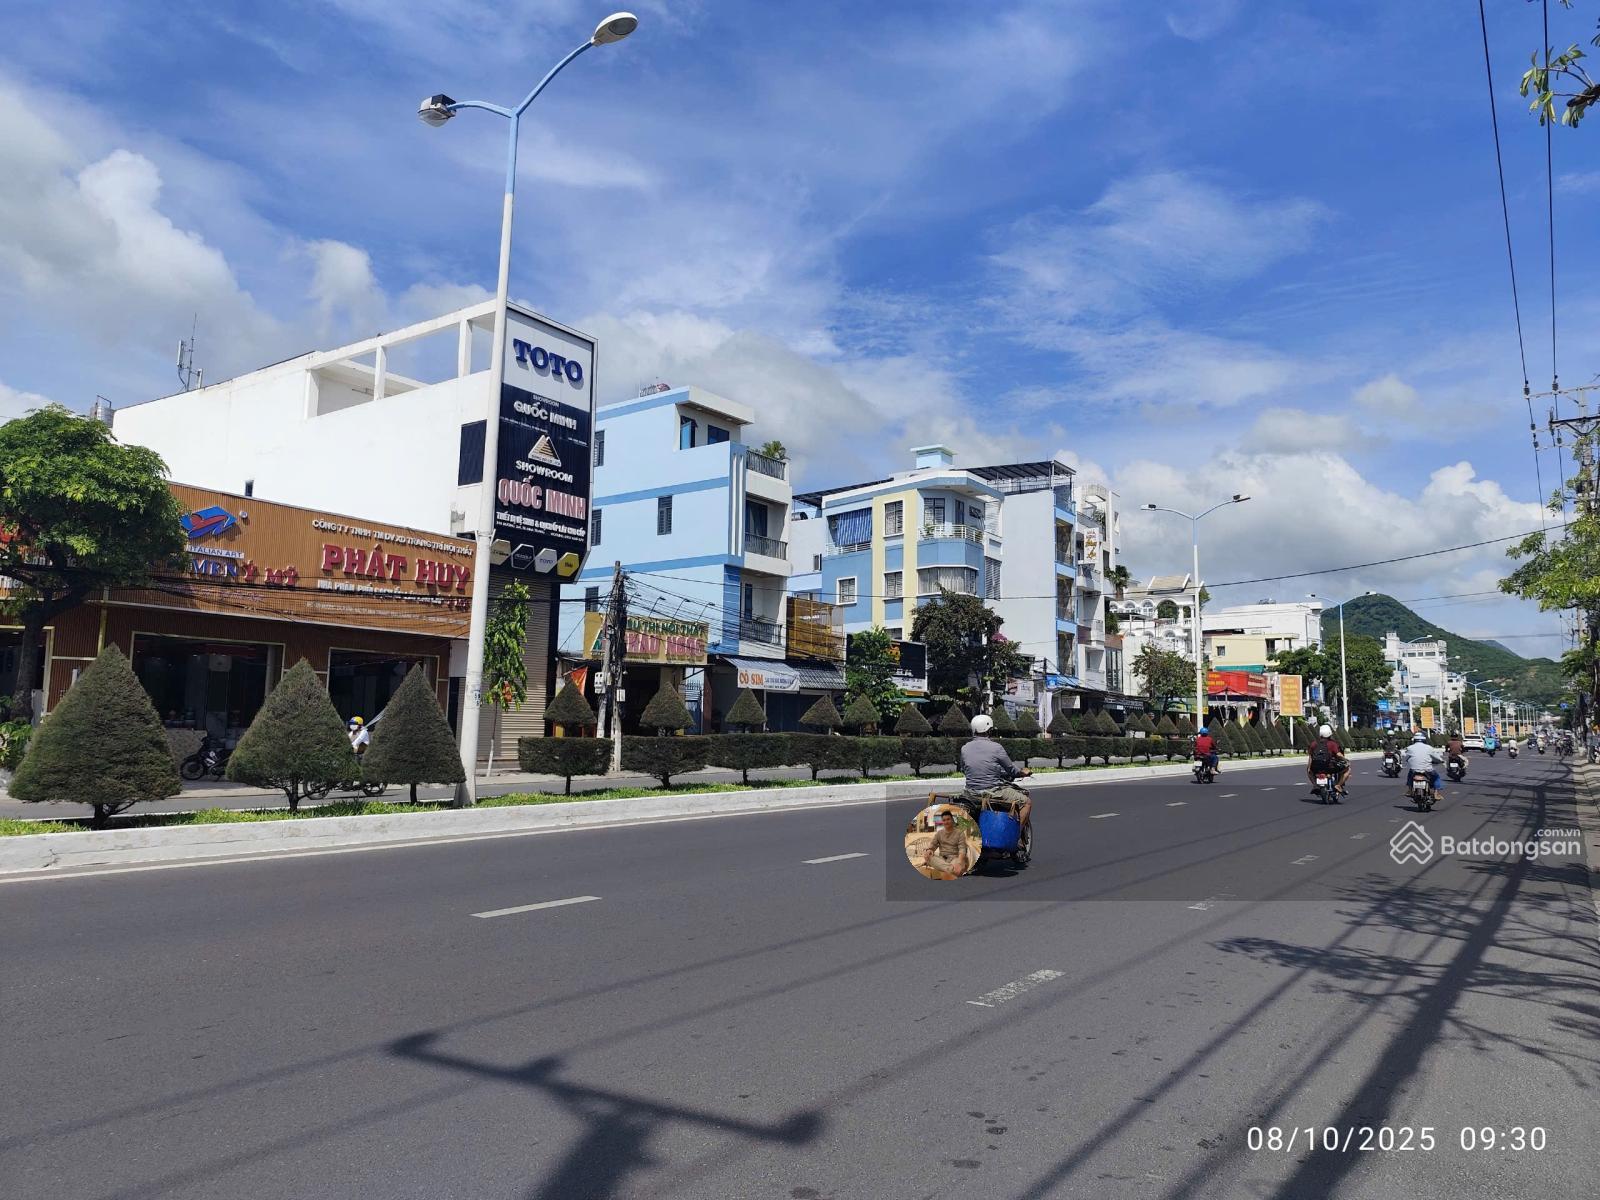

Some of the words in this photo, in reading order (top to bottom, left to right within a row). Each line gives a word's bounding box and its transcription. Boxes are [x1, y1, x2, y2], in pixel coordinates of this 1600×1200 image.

[513, 338, 583, 382] TOTO
[513, 400, 548, 420] QUỐC
[549, 412, 577, 430] MINH
[515, 460, 573, 484] SHOWROOM
[498, 475, 542, 509] QUỐC
[545, 488, 586, 520] MINH
[312, 519, 337, 531] CÔNG
[337, 524, 349, 533] TY
[350, 526, 372, 537] TNHH
[407, 537, 432, 548] TRANG
[189, 545, 223, 556] ITALIAN
[415, 558, 471, 590] HUY
